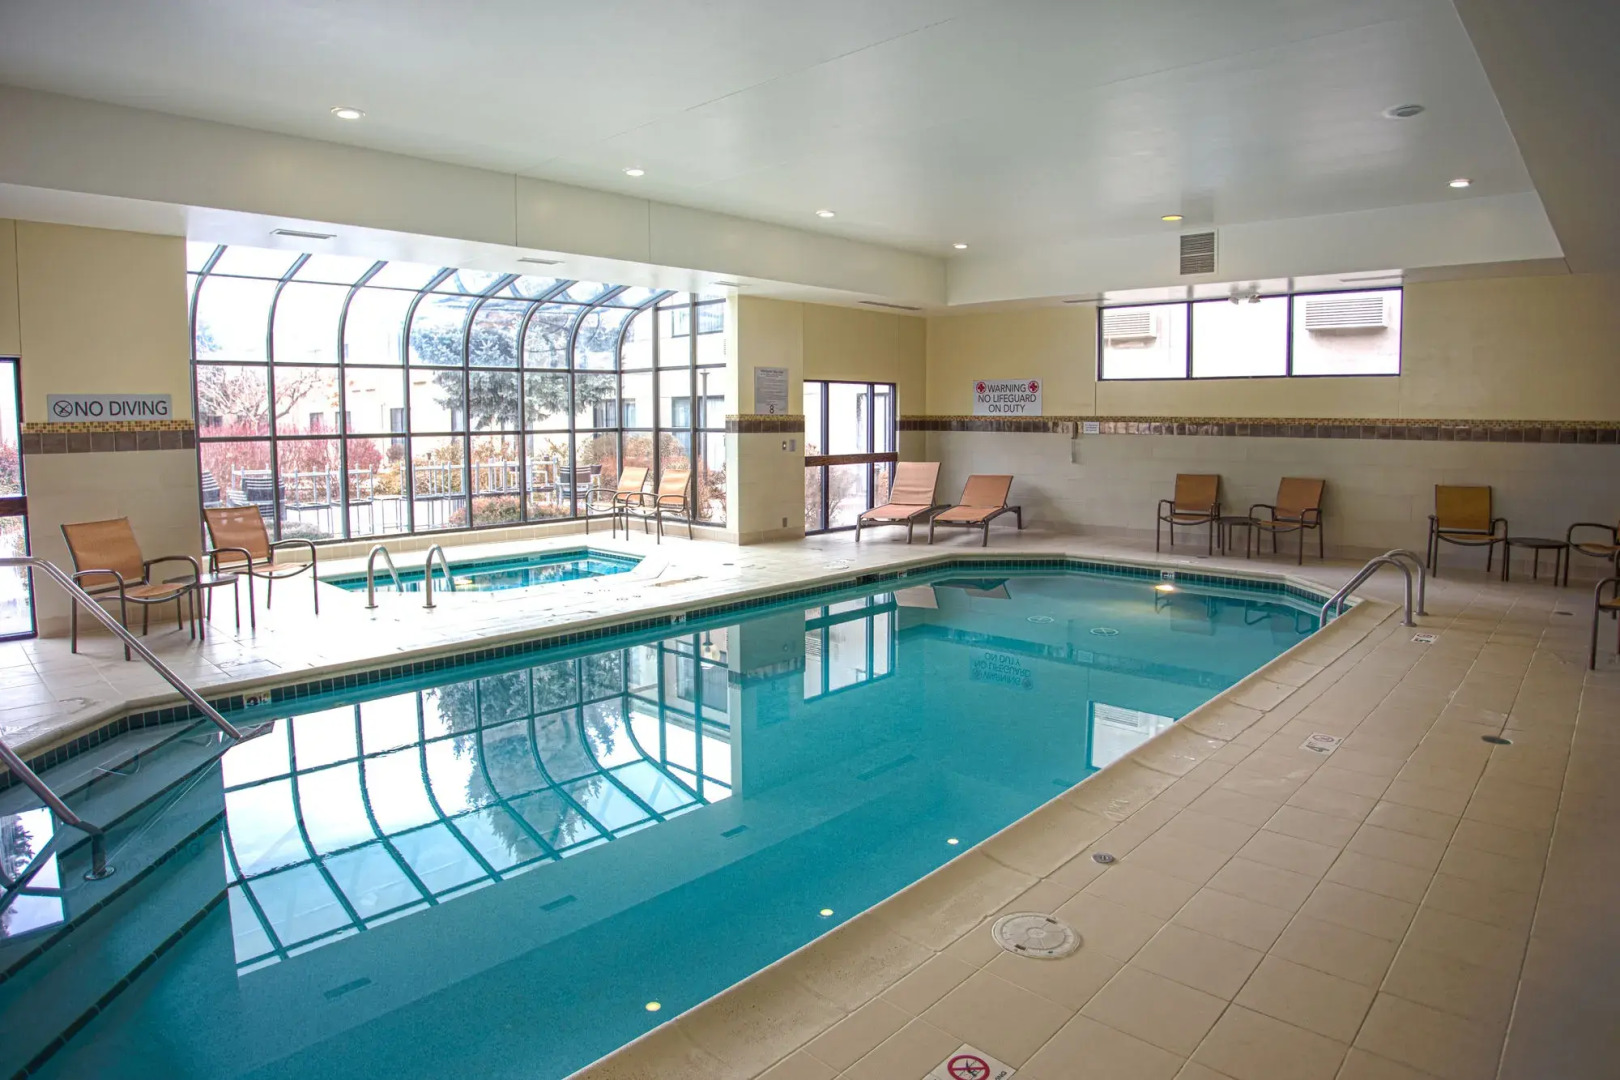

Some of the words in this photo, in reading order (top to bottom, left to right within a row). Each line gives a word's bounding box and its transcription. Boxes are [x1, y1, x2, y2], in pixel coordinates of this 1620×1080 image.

[987, 383, 1027, 393] WARNING
[978, 394, 991, 403] NO
[993, 393, 1037, 403] LIFEGUARD
[74, 401, 103, 417] NO
[109, 400, 168, 416] DIVING
[988, 404, 1002, 413] ON
[1004, 404, 1026, 413] DUTY
